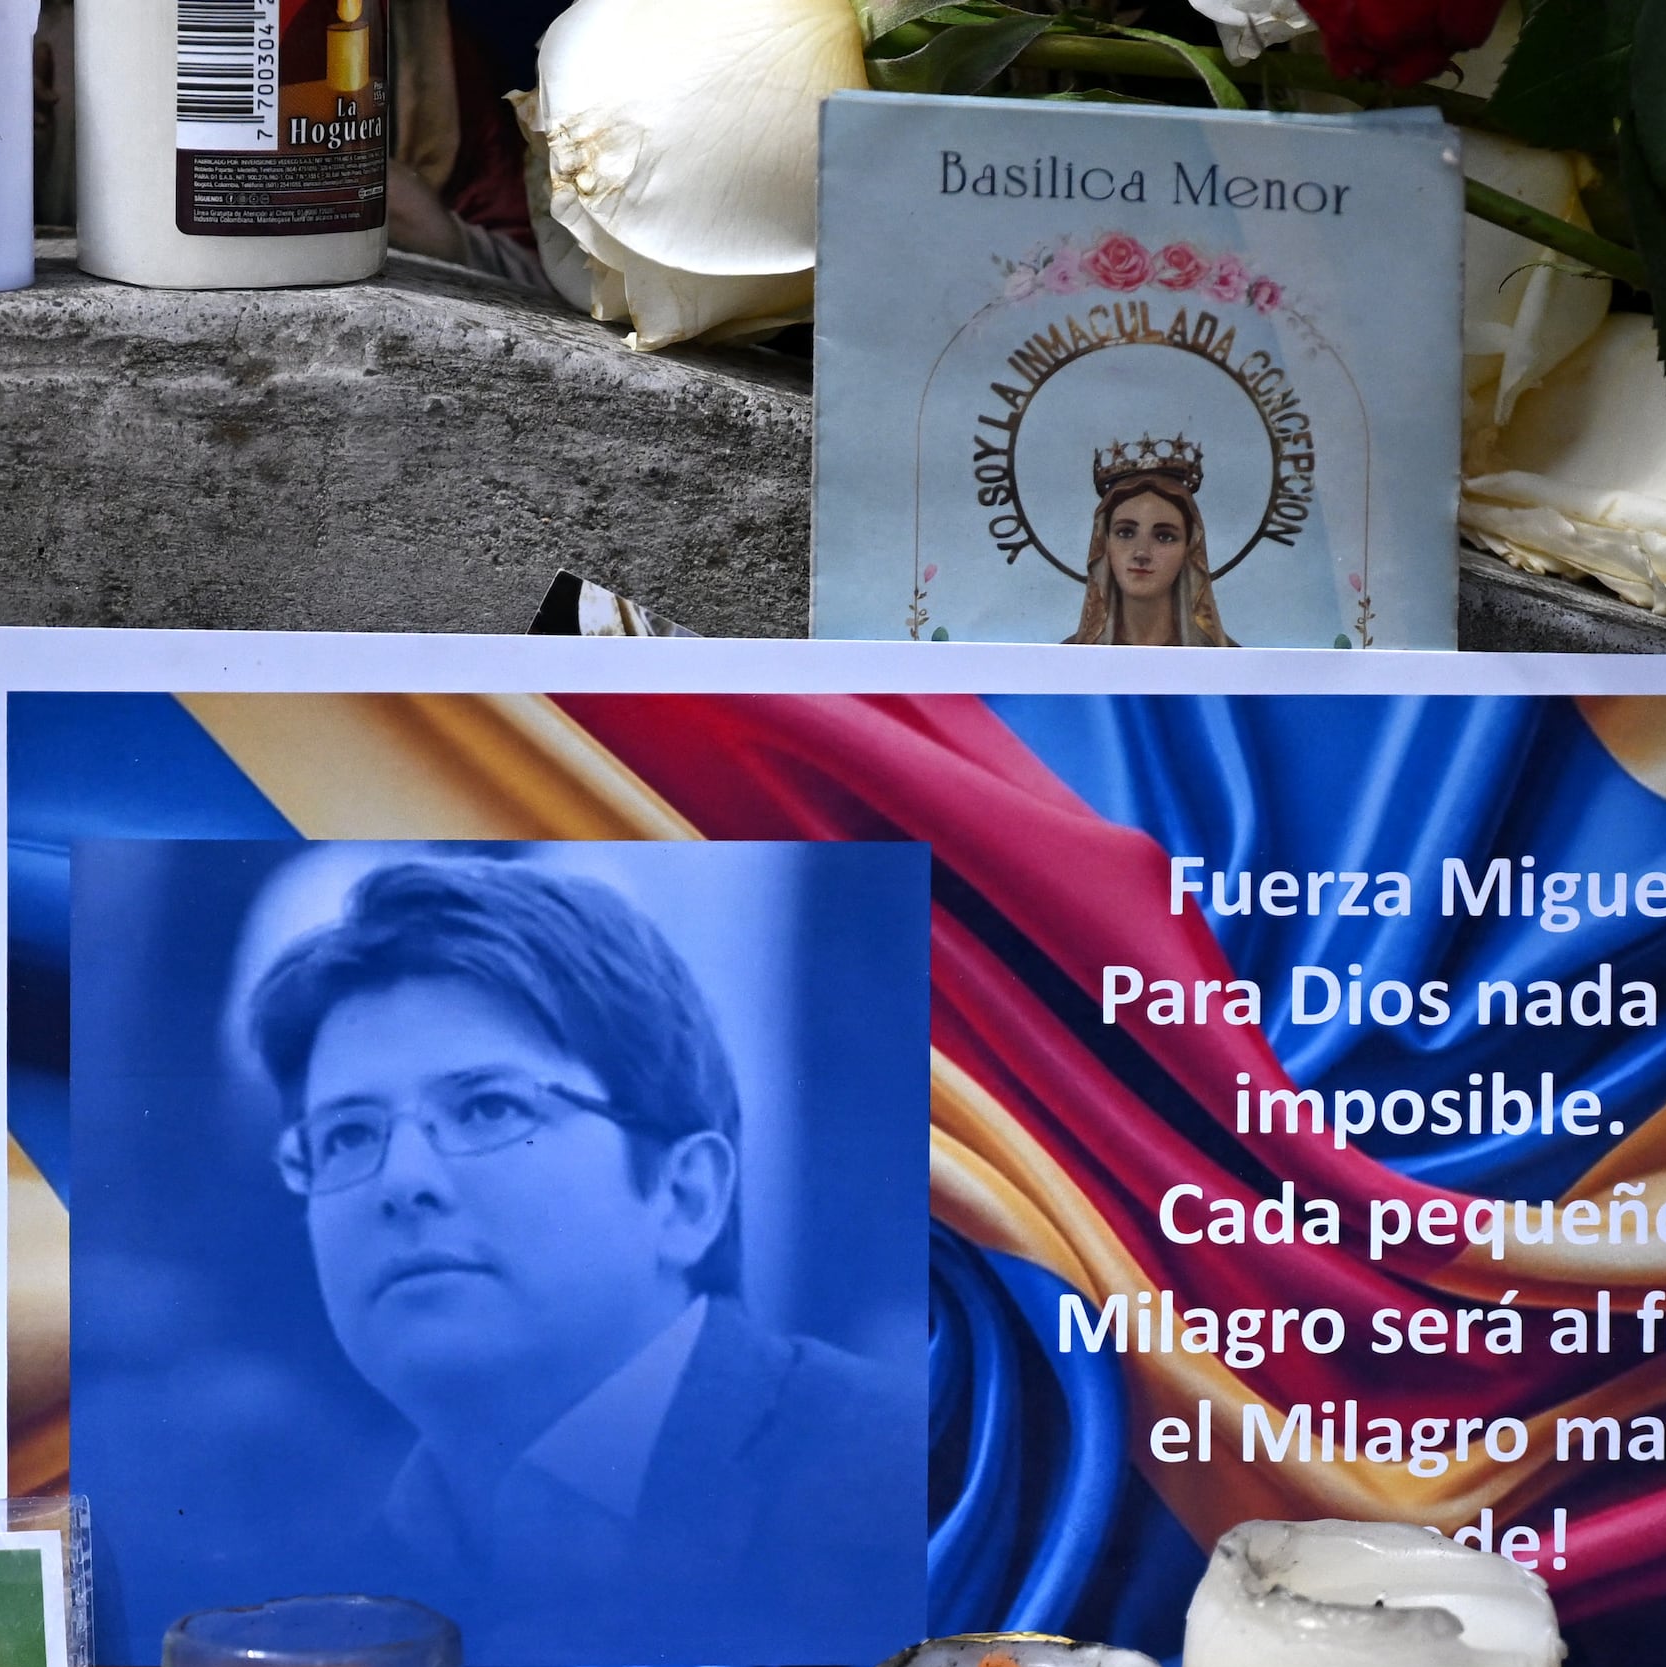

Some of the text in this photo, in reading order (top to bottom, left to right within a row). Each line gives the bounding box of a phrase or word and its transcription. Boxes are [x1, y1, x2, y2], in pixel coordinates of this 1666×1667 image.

[290, 116, 382, 150] Hoguera
[337, 98, 357, 117] La
[1172, 161, 1352, 216] Menor
[973, 301, 1316, 565] YO SOY LA INMACULADA CONCEPCION
[1170, 857, 1411, 917] Fuerza
[1102, 965, 1261, 1026] Para
[1292, 964, 1450, 1026] Dios
[1478, 963, 1657, 1027] nada
[1236, 1071, 1624, 1150] imposible.
[1159, 1180, 1340, 1245] Cada
[1059, 1290, 1345, 1369] Milagro
[1371, 1289, 1522, 1355] será
[1550, 1290, 1610, 1354] al
[1150, 1399, 1212, 1463] el
[1242, 1399, 1528, 1478] Milagro
[1422, 1507, 1568, 1571] de!
